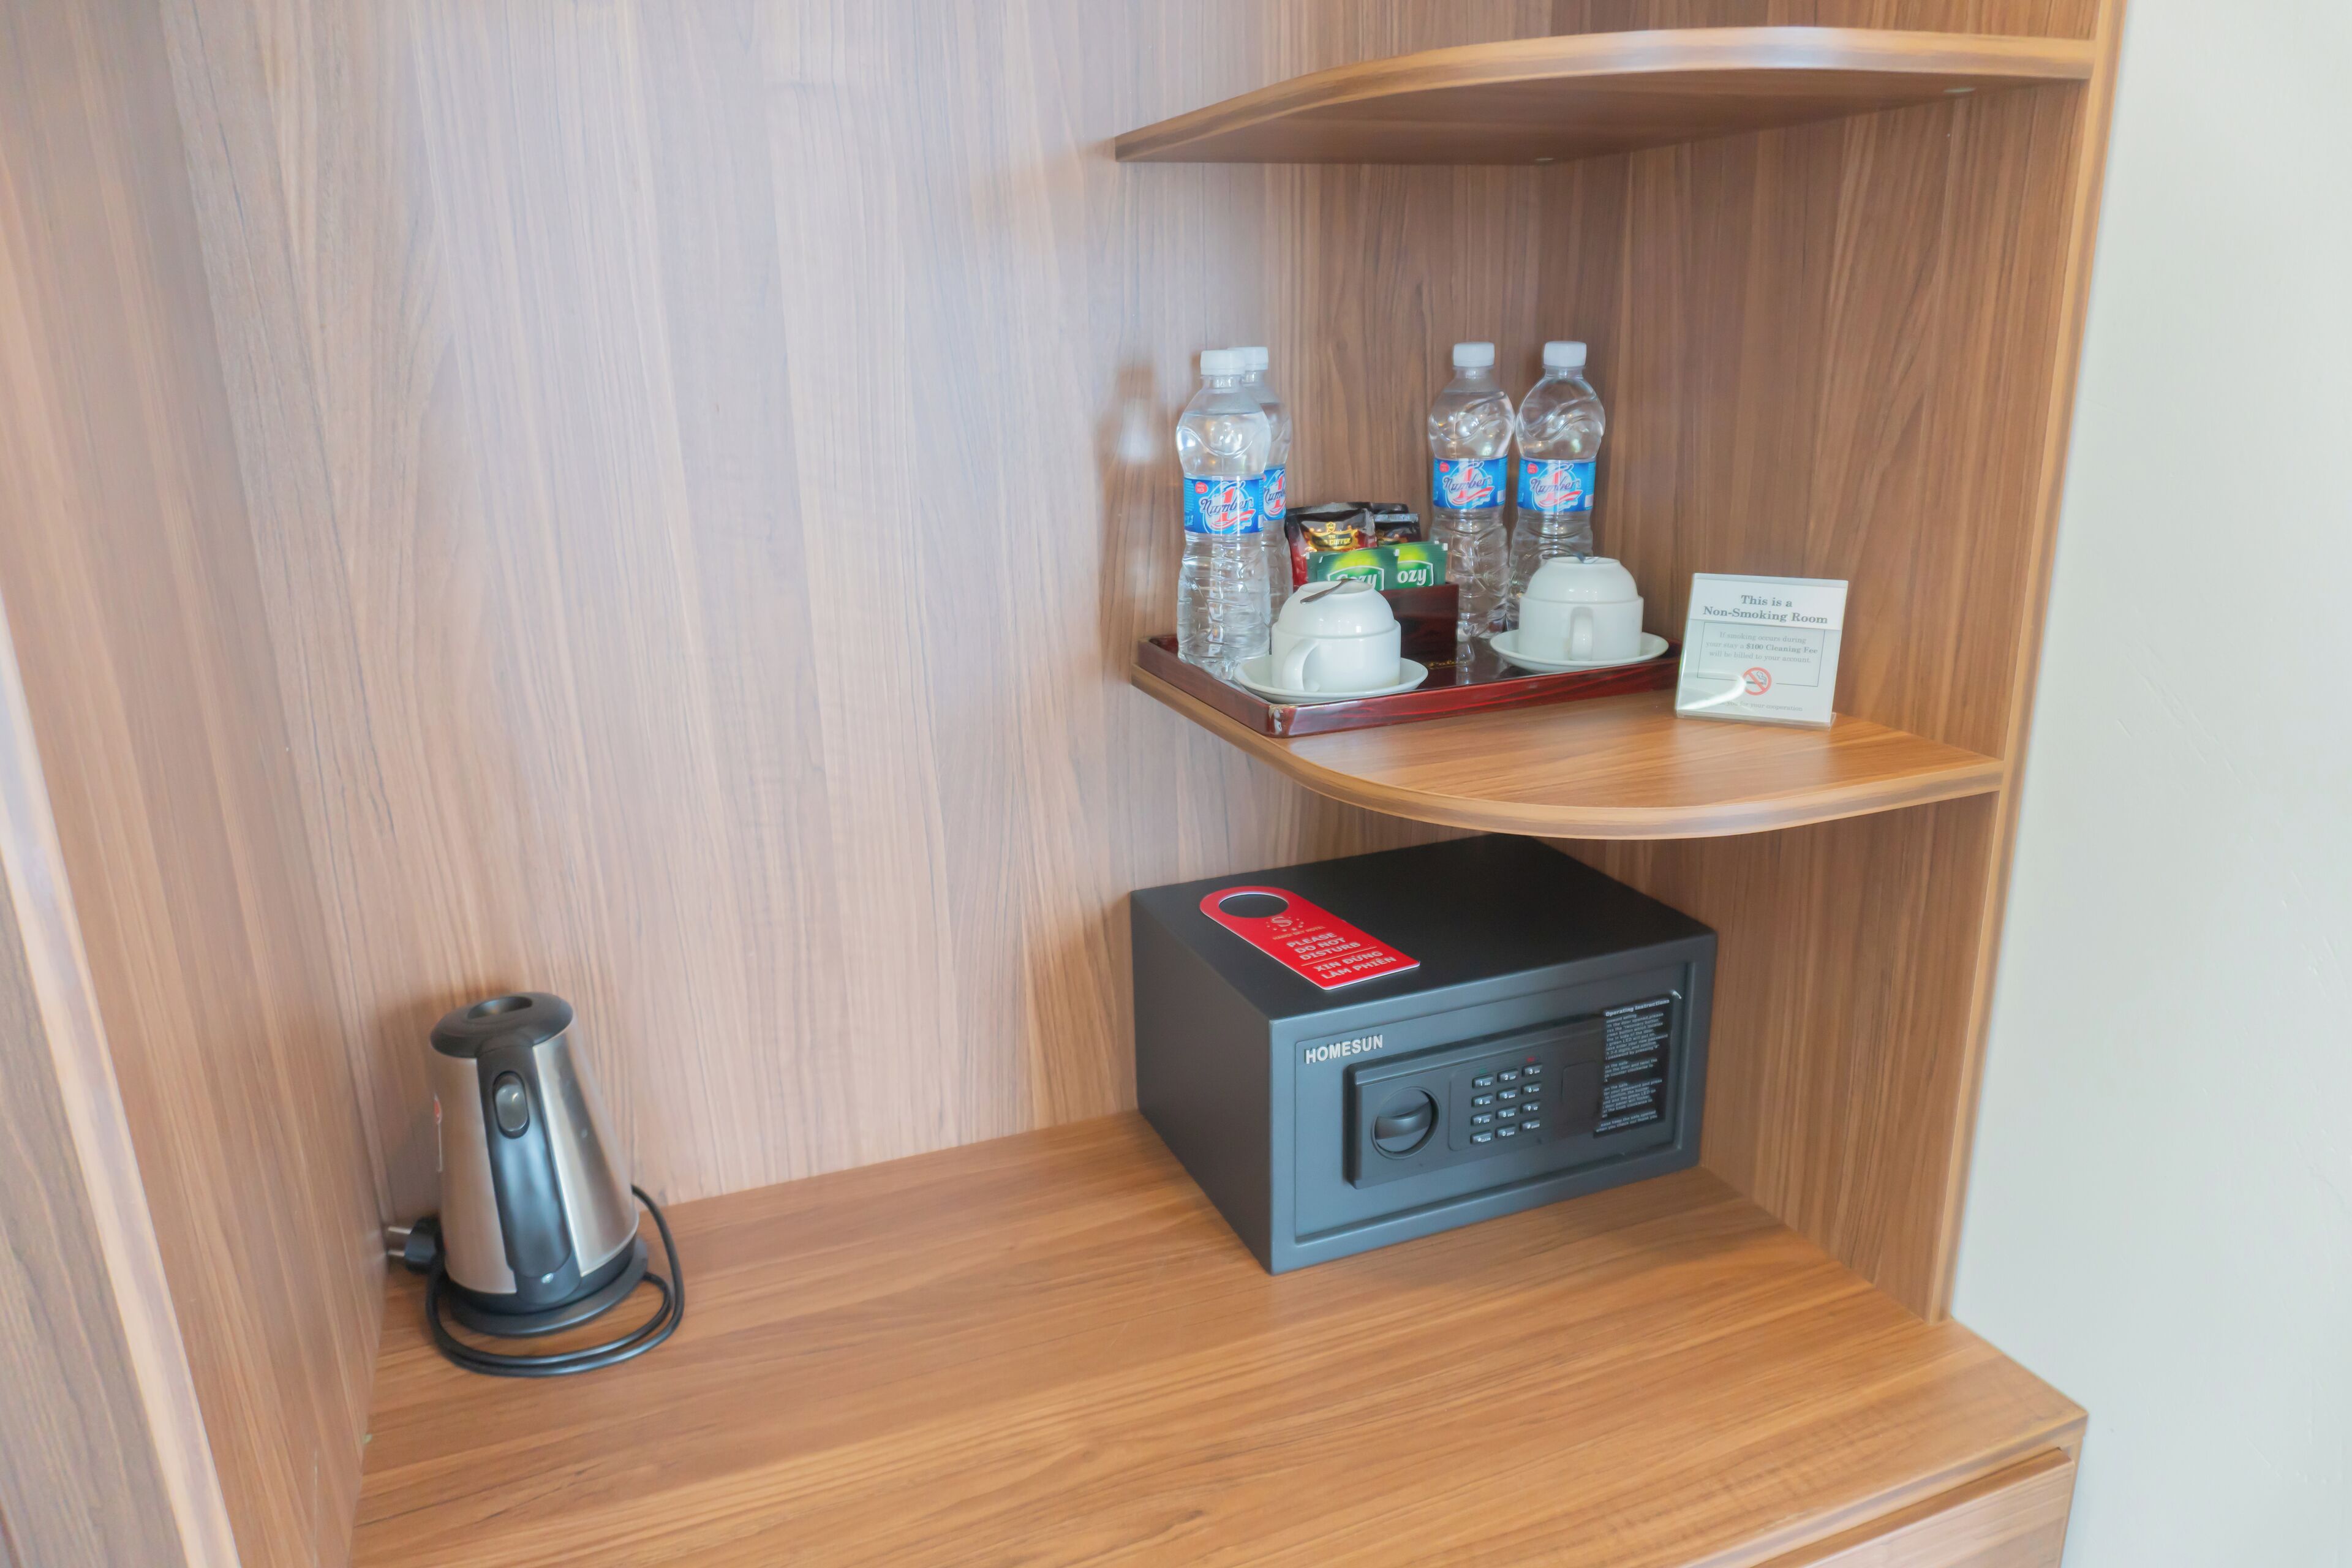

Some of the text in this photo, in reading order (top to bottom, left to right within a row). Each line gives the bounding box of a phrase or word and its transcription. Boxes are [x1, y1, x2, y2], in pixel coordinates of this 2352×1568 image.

[1443, 474, 1492, 492] Number
[1531, 475, 1580, 494] Number
[1200, 492, 1253, 516] Number
[1397, 568, 1427, 586] ozy
[1741, 595, 1768, 606] This
[1771, 597, 1782, 606] is
[1703, 606, 1828, 624] Non-Smoking Room
[1727, 633, 1756, 641] smoking
[1782, 635, 1807, 644] during
[1766, 644, 1801, 654] Cleaning
[1286, 932, 1337, 948] PLEASE
[1294, 937, 1346, 954] DO NOT
[1299, 941, 1361, 960] DISTURB
[1313, 961, 1341, 972] XIN
[1605, 1000, 1670, 1017] Operating Instructions
[1305, 1035, 1383, 1064] HOMESUN
